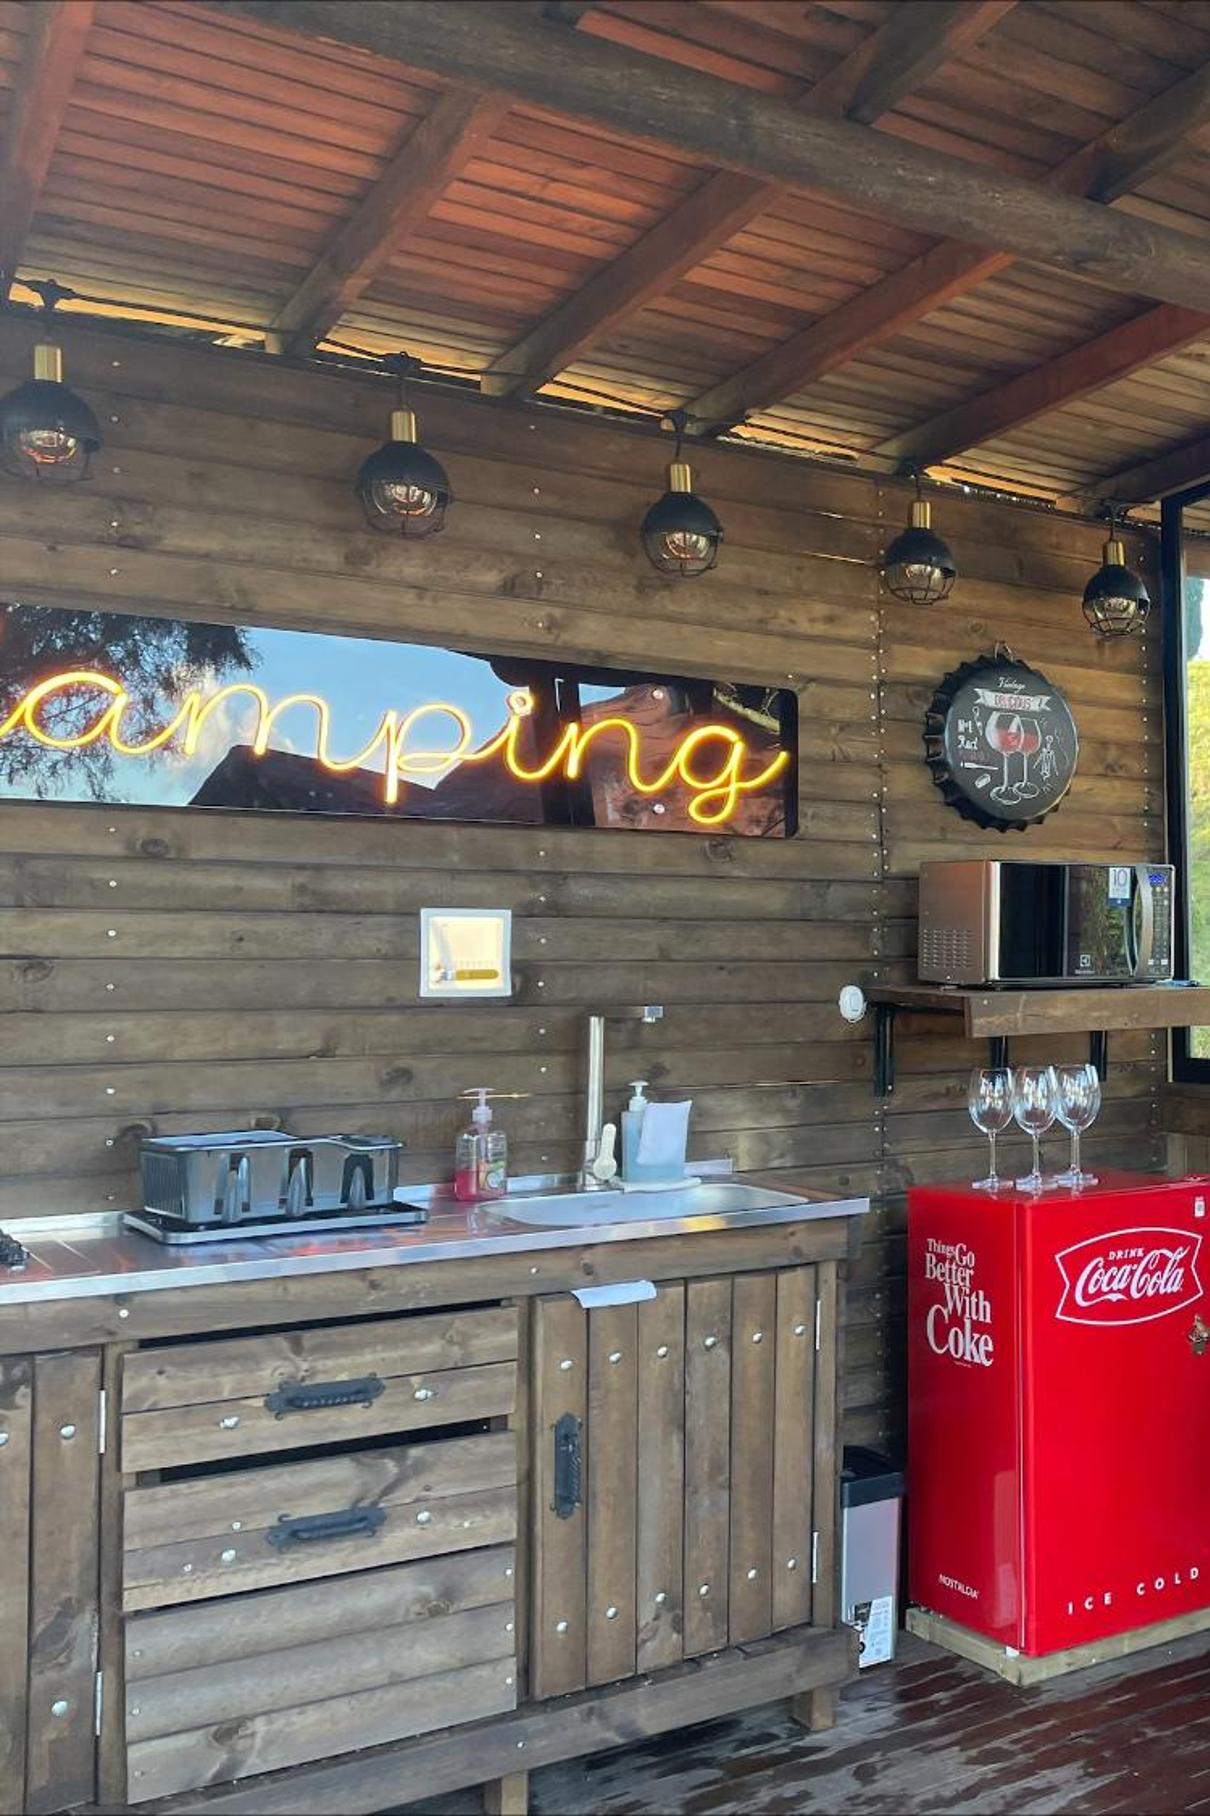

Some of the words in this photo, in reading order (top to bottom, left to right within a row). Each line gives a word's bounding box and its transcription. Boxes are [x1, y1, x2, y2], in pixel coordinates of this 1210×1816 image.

[0, 671, 789, 824] amping
[924, 1253, 974, 1288] Better
[926, 1238, 956, 1259] Things
[955, 1243, 975, 1268] Go
[1108, 1248, 1145, 1260] DRINK
[1075, 1246, 1191, 1307] Coca-Cola
[943, 1282, 991, 1323] With
[926, 1304, 993, 1367] Coke
[1068, 1592, 1112, 1615] ICE
[1136, 1567, 1199, 1596] COLD
